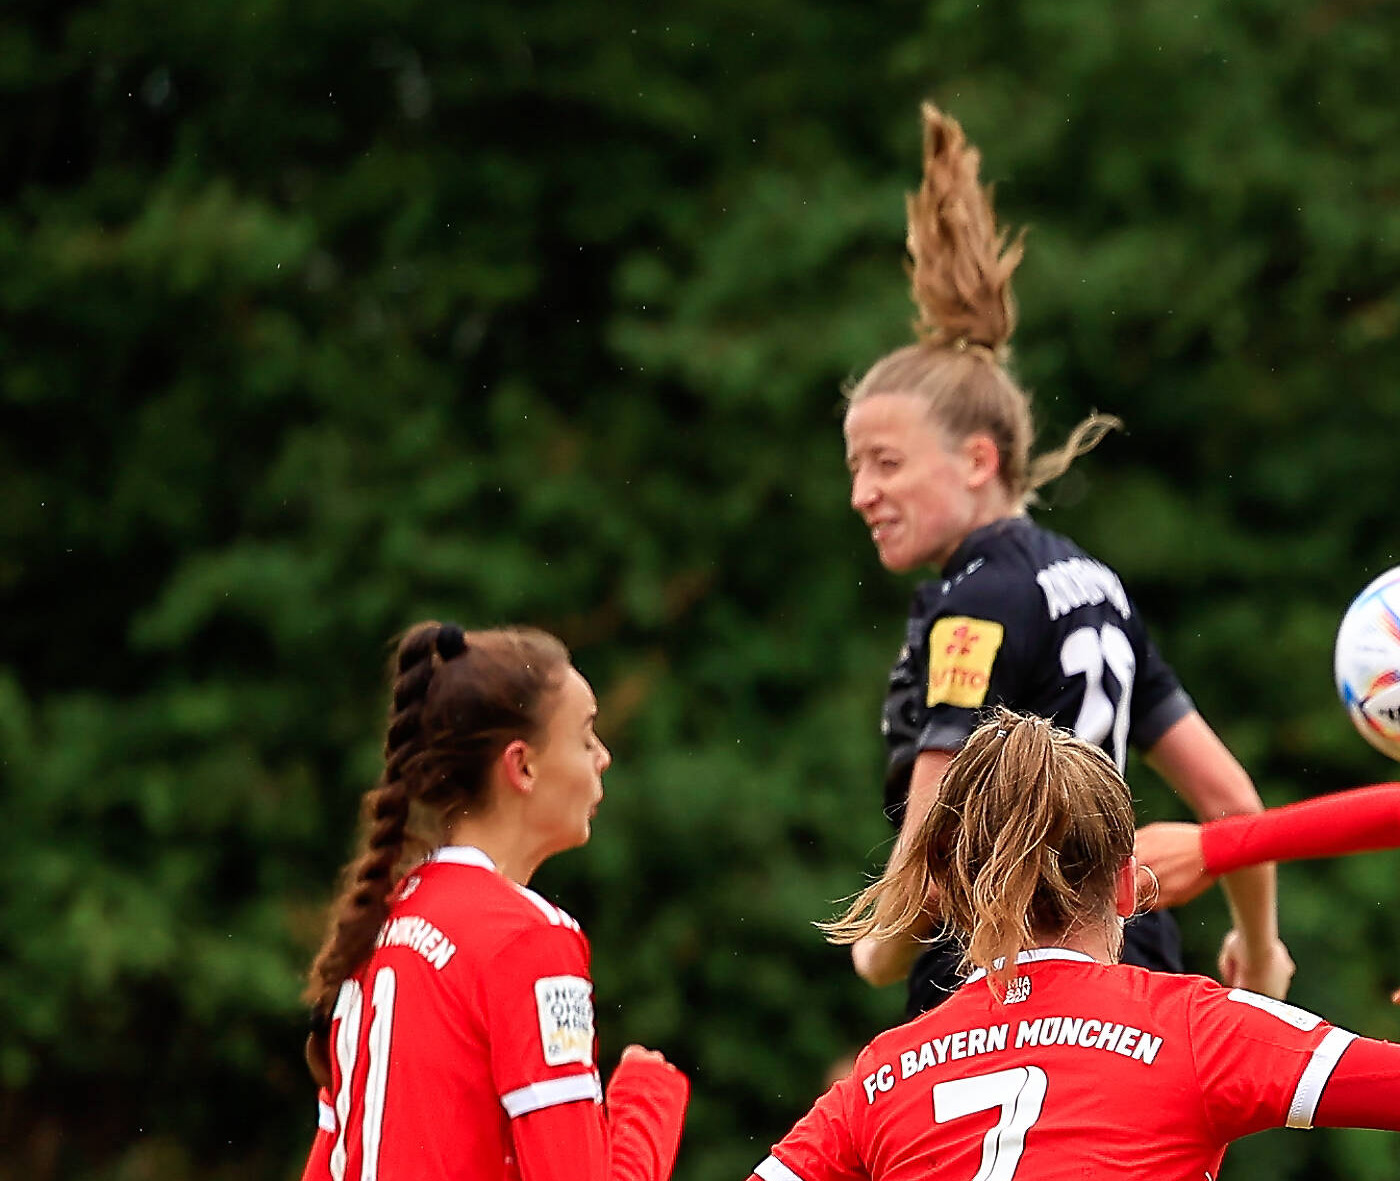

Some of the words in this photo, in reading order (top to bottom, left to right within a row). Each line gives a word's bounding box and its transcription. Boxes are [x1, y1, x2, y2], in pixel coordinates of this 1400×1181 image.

[862, 1064, 895, 1105] FC
[899, 1022, 1009, 1079] BAYERN
[1014, 1016, 1163, 1066] MÜNCHEN
